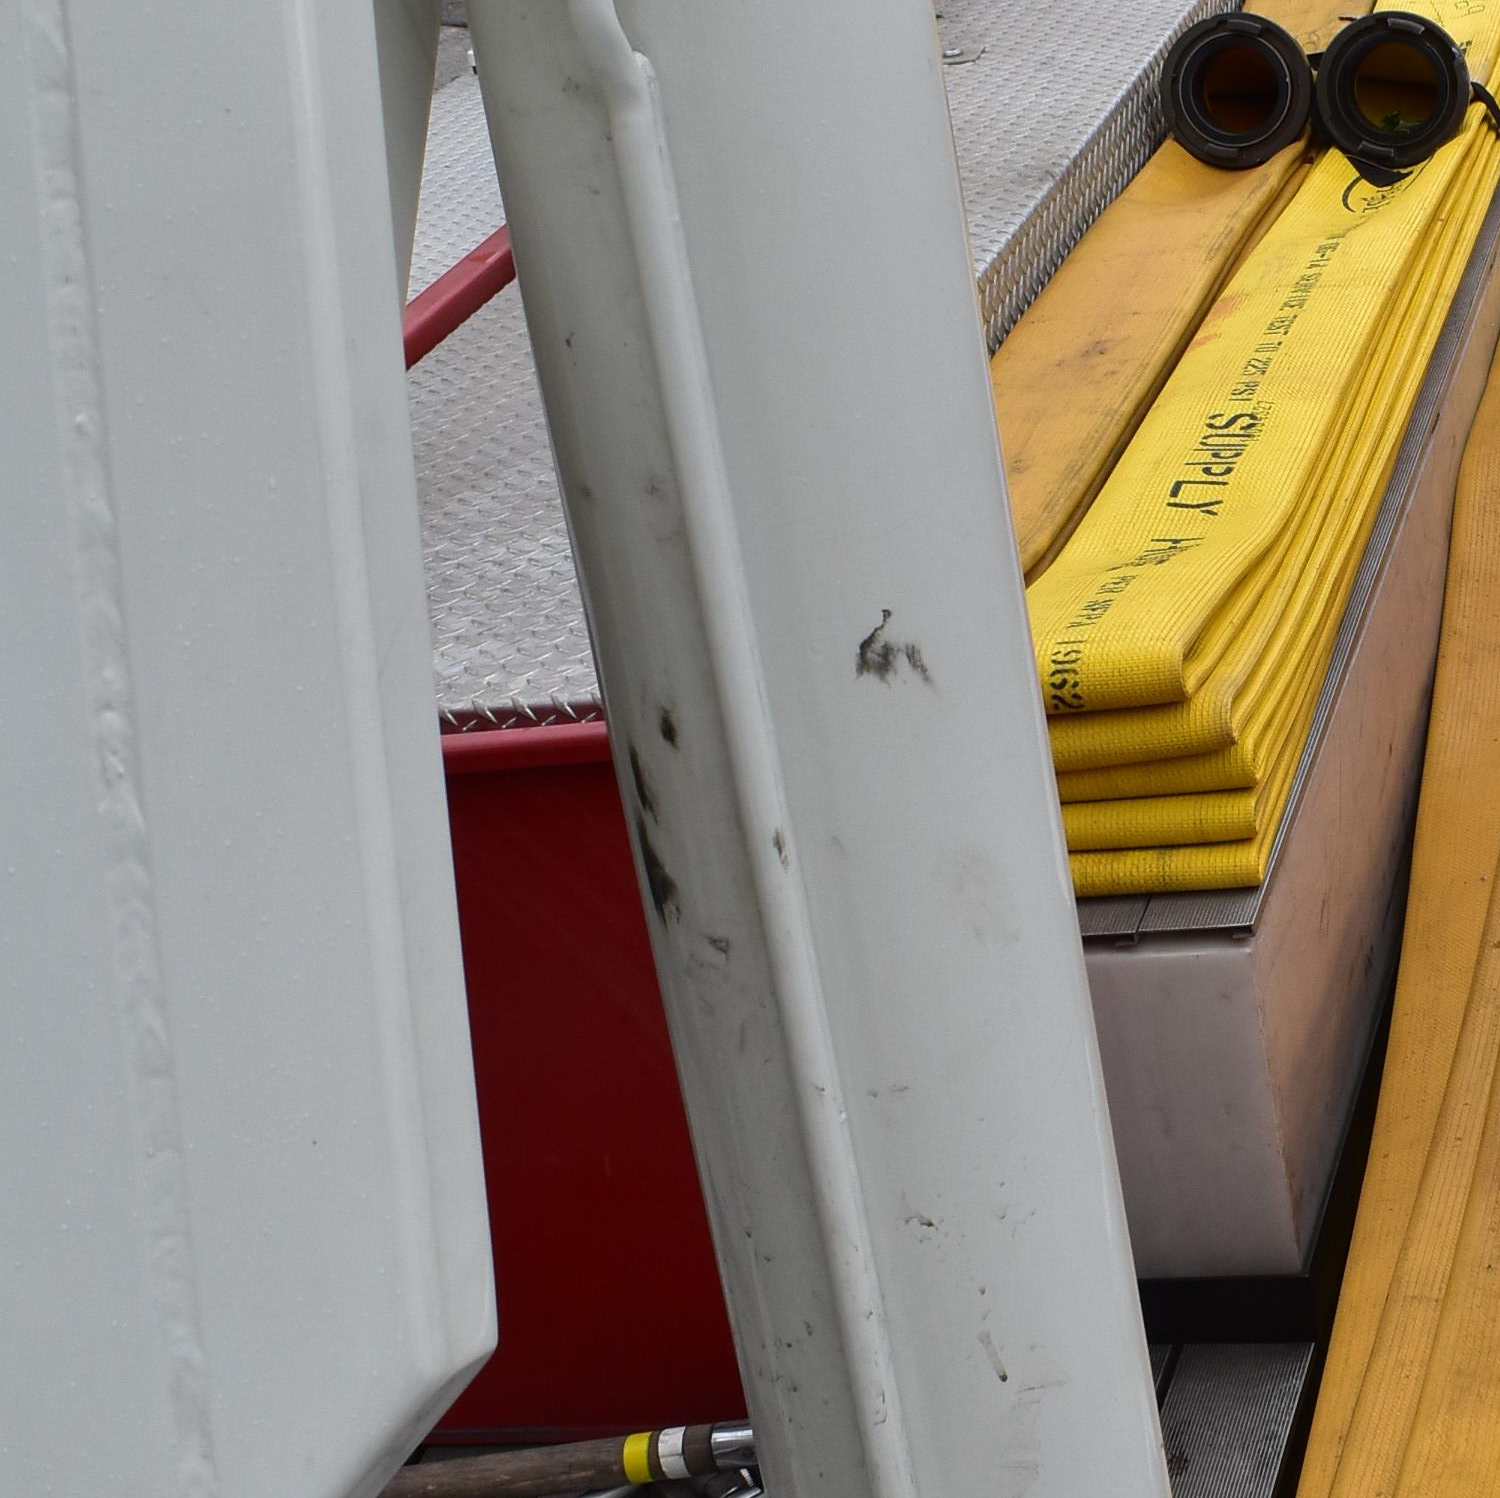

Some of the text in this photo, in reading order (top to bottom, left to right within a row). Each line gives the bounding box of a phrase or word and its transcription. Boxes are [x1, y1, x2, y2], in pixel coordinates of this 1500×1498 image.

[1263, 314, 1298, 335] TEST
[1254, 341, 1282, 353] TO
[1242, 357, 1273, 376] 225
[1227, 381, 1260, 401] PSI
[1166, 413, 1259, 516] SUPPLY
[1049, 640, 1088, 710] 1962
